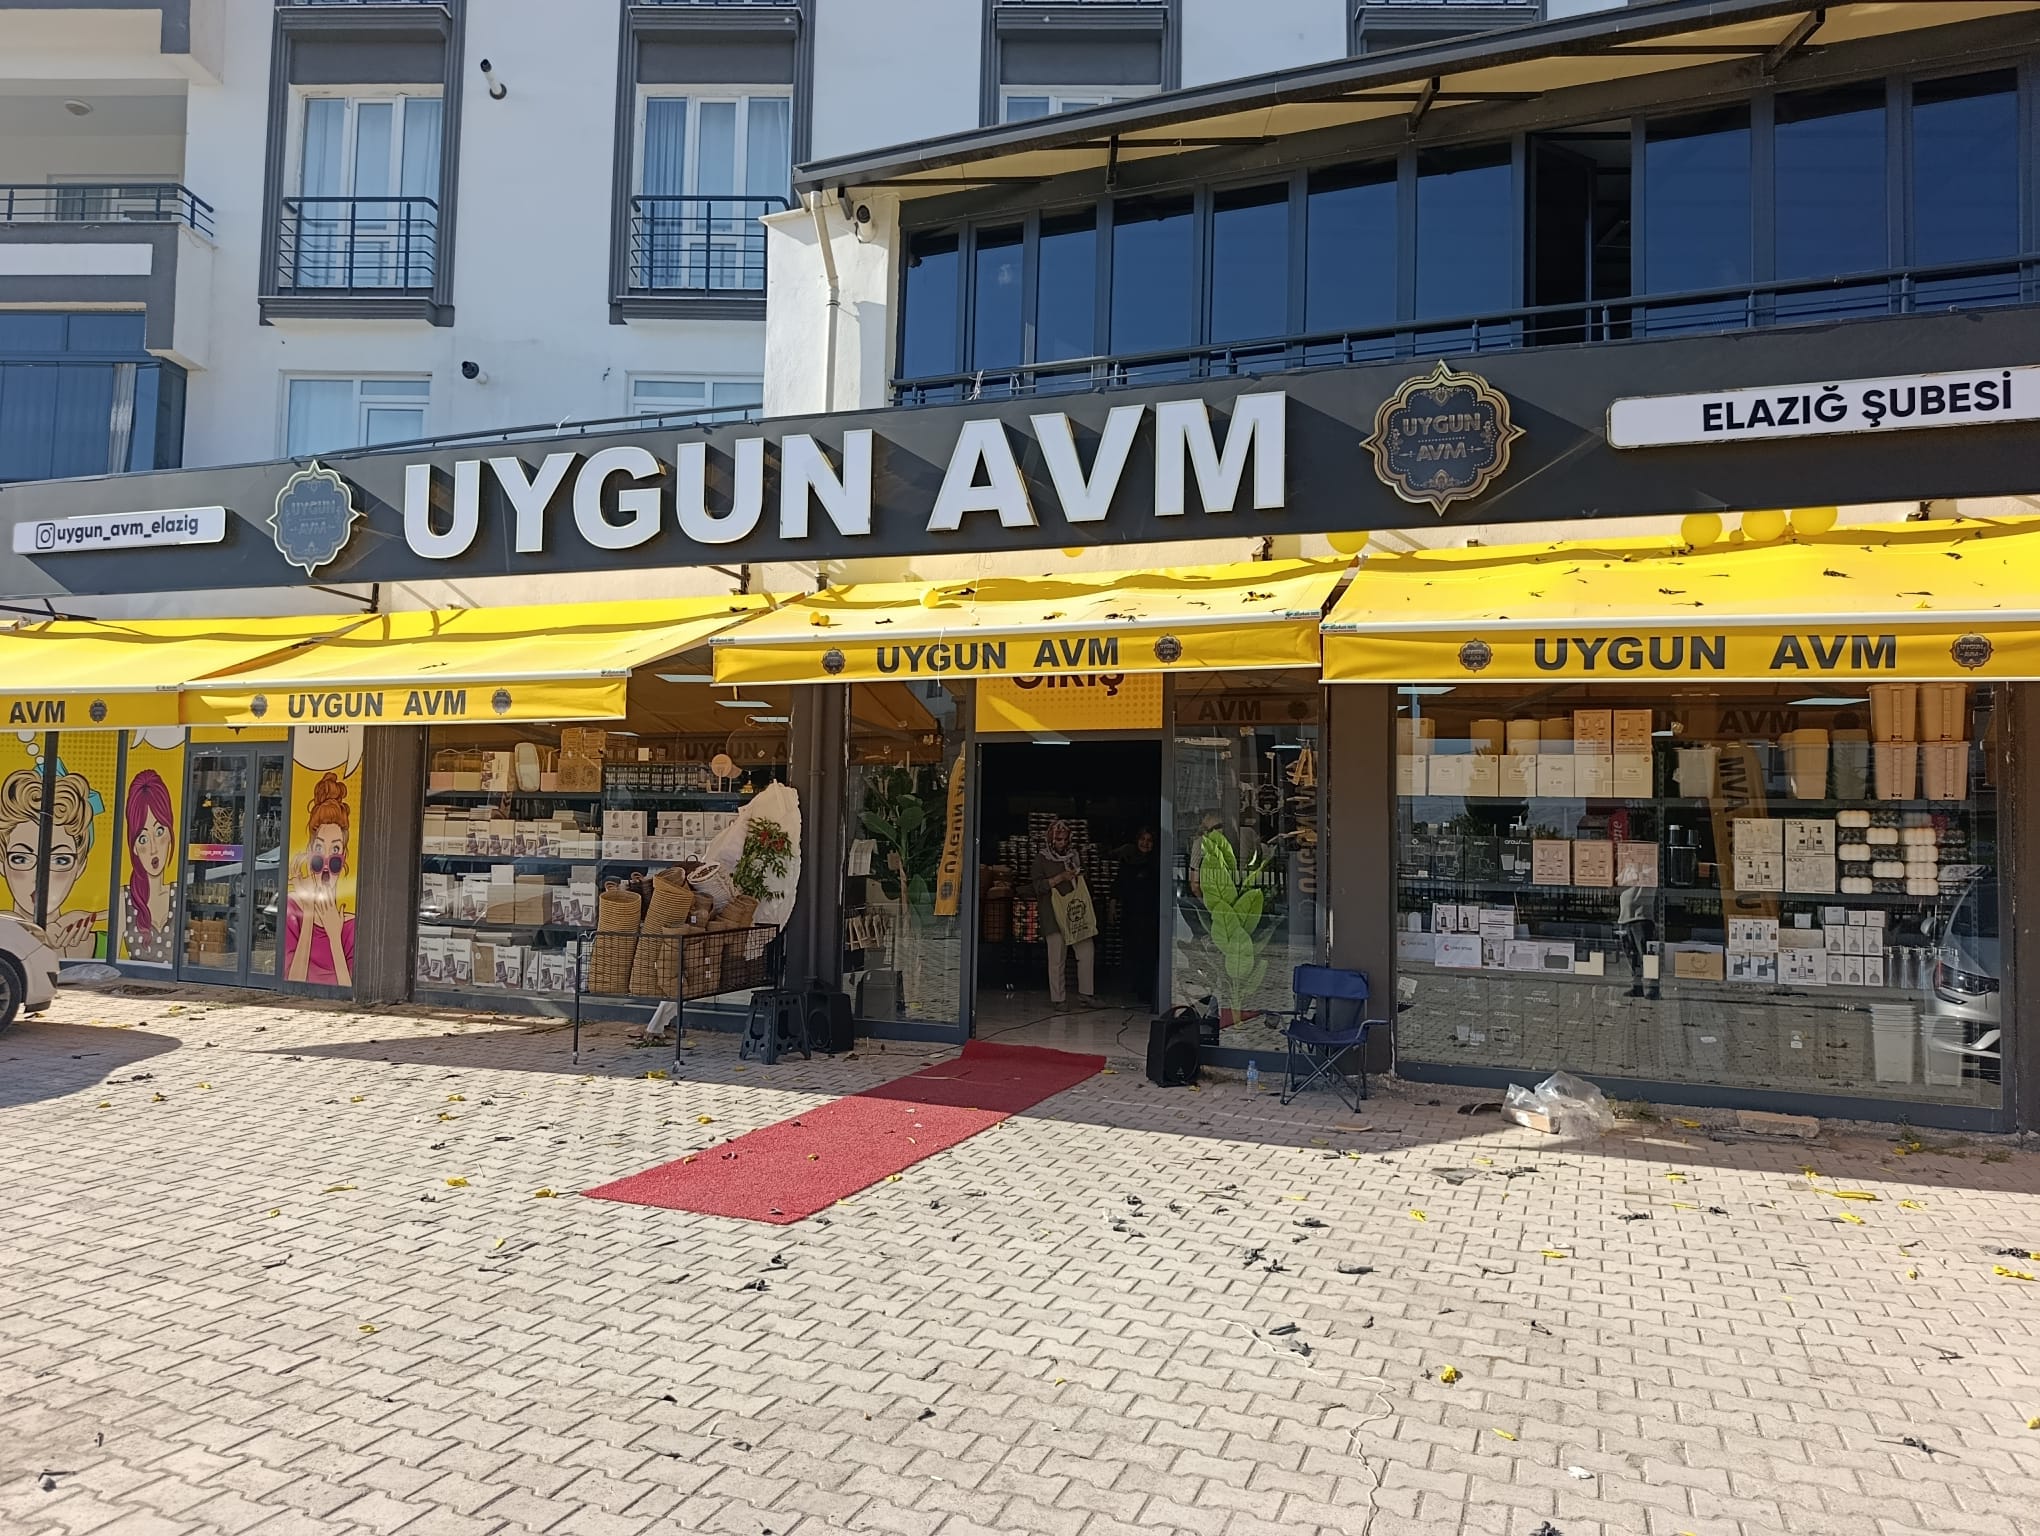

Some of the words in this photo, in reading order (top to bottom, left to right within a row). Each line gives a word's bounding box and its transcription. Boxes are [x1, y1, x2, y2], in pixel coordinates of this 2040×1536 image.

[1703, 385, 1847, 432] ELAZIĞ
[1861, 371, 2012, 428] ŞUBESİ
[1401, 412, 1481, 437] UYGUN
[1416, 441, 1467, 462] AVM
[404, 428, 873, 559] UYGUN
[926, 391, 1286, 532] AVM
[291, 500, 336, 516] UYGUN
[57, 514, 199, 544] uygun_avm_elazig
[298, 521, 327, 535] AVM
[875, 640, 1006, 673] UYGUN
[1032, 636, 1120, 668] AVM
[1533, 635, 1727, 671] UYGUN
[1768, 633, 1897, 669] AVM
[9, 700, 65, 724] AVM
[288, 693, 384, 718] UYGUN
[403, 689, 466, 716] AVM
